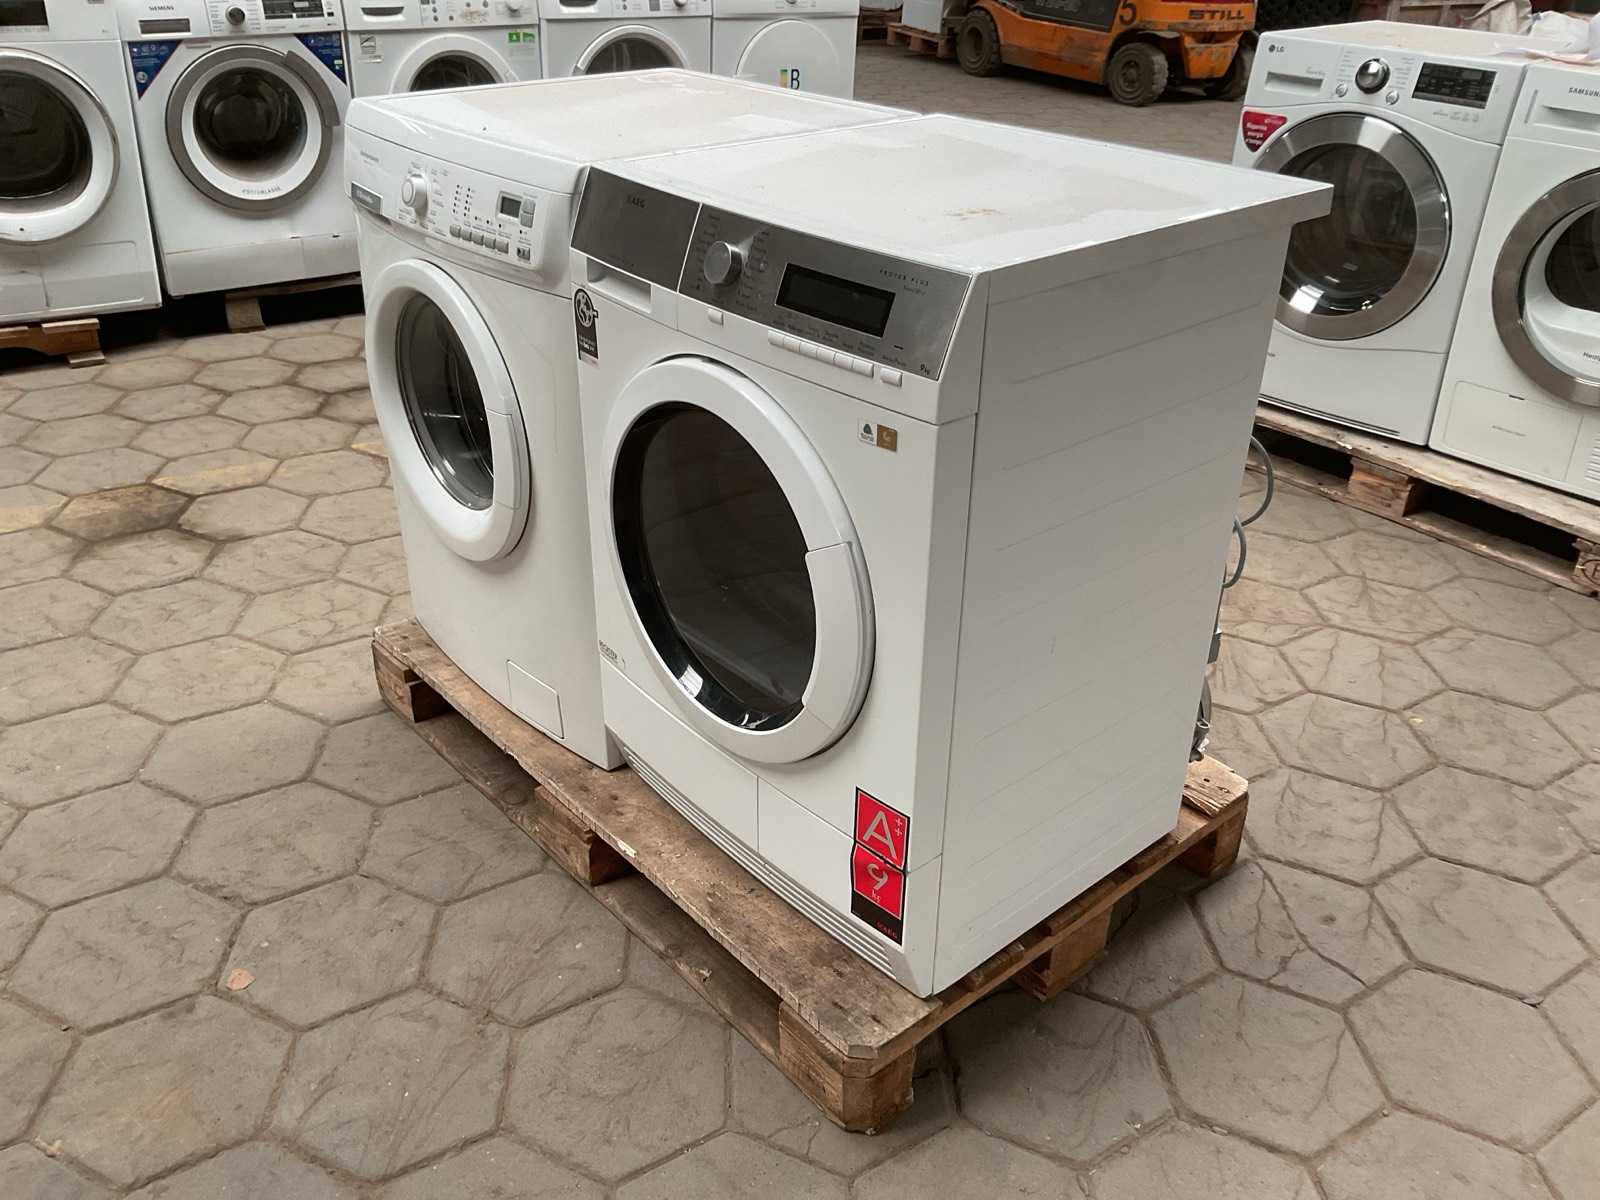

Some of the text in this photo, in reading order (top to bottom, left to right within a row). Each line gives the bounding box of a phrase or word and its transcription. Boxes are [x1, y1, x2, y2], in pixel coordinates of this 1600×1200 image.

[1188, 9, 1245, 21] STILL
[790, 68, 800, 90] B
[1569, 86, 1600, 97] SAMSUN
[866, 863, 889, 891] 9
